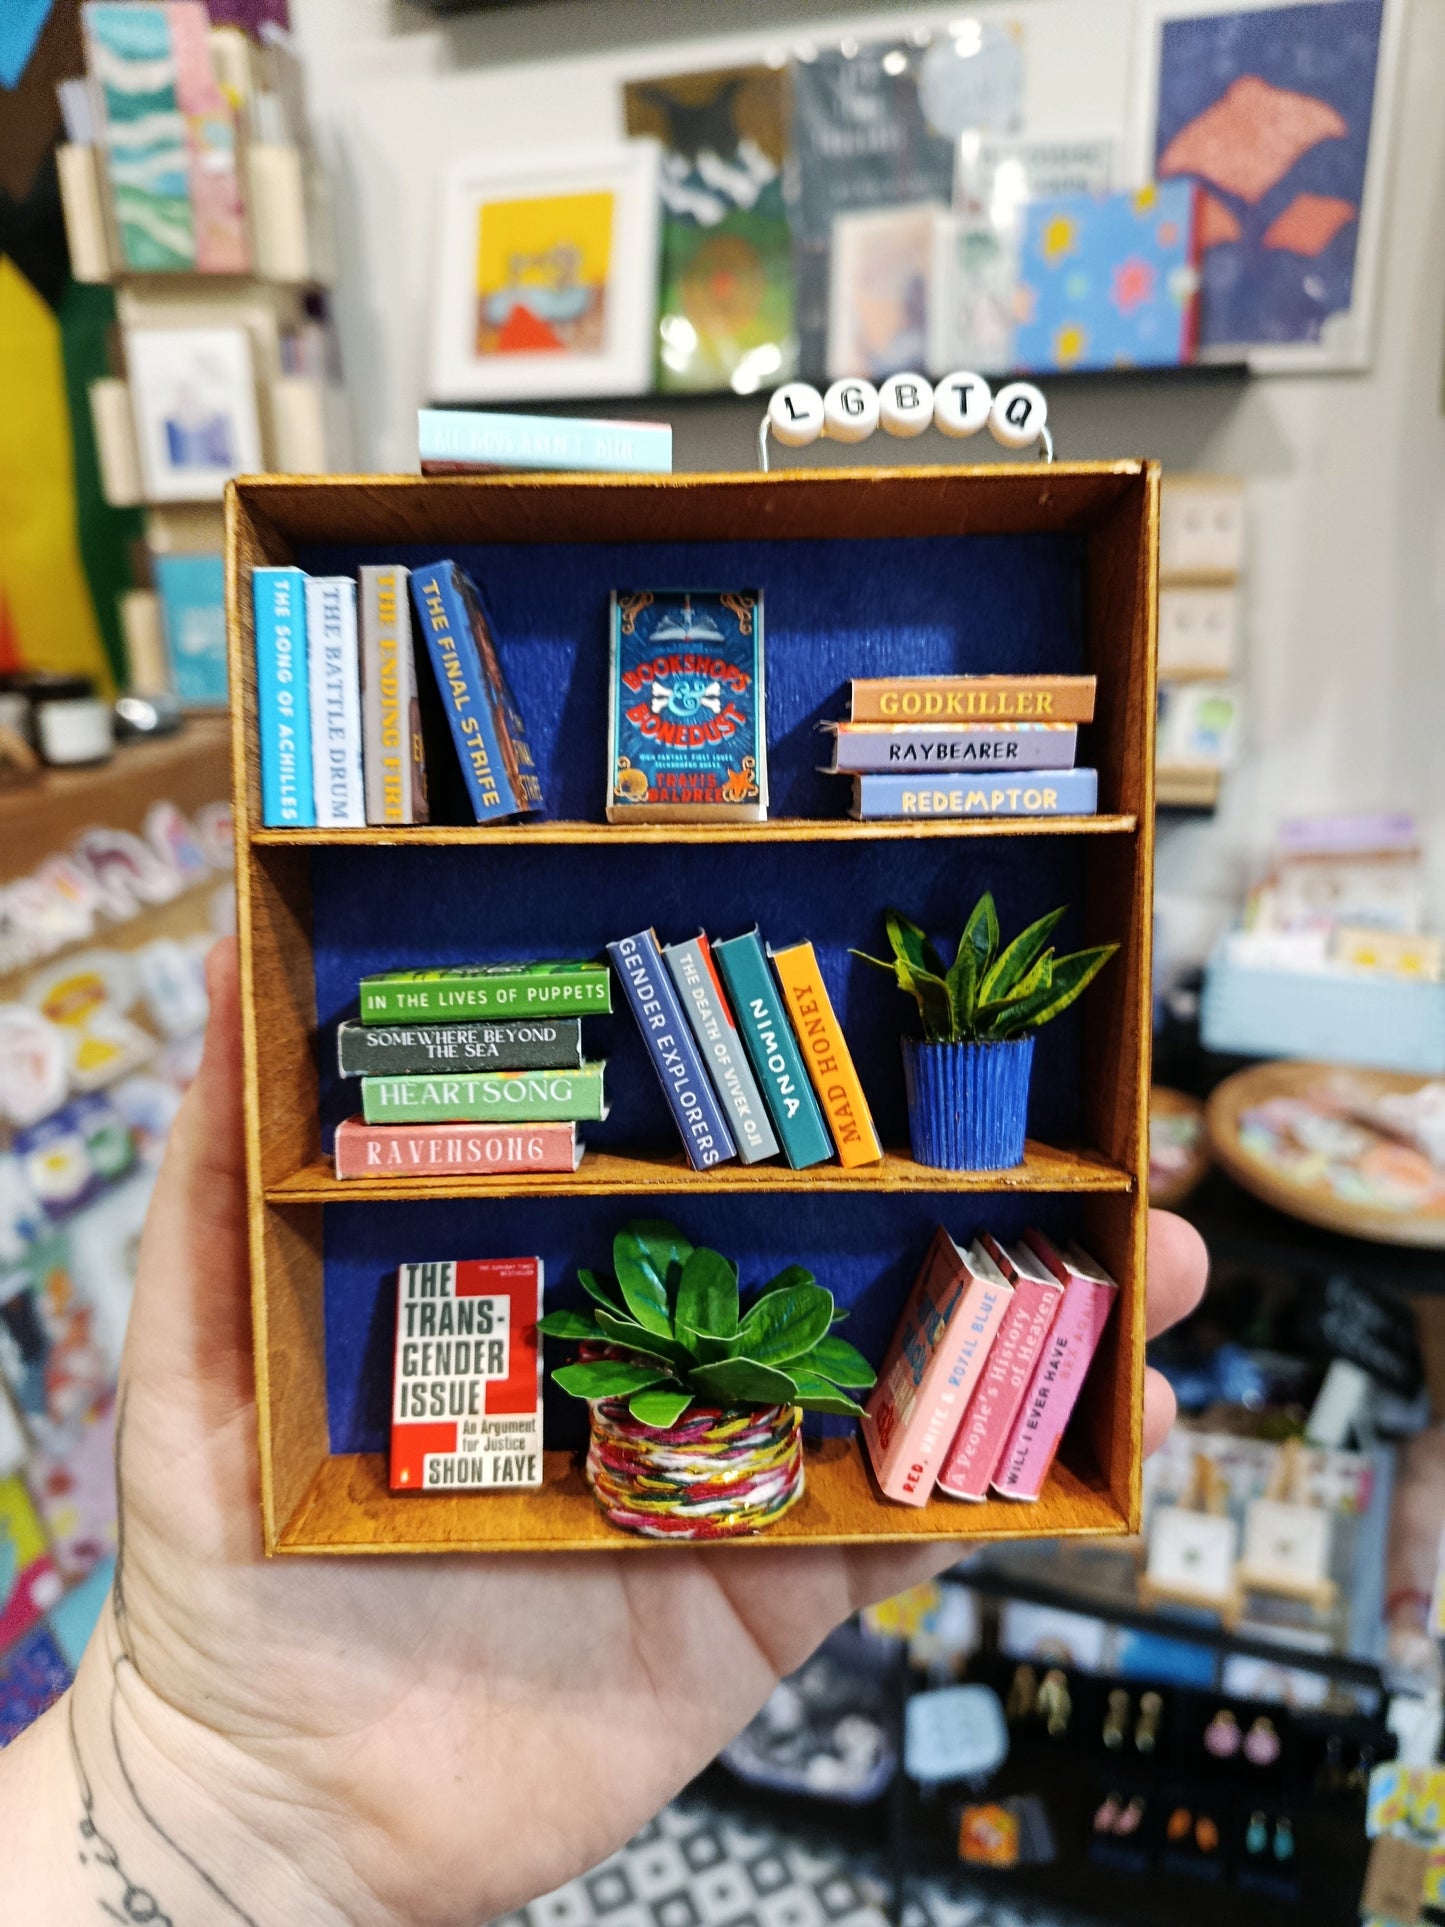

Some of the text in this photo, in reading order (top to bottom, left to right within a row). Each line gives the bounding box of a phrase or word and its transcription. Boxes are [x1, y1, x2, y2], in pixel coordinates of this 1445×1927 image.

[784, 384, 1033, 430] LGBTQ
[422, 578, 501, 808] THE FINAL STRIFE
[621, 653, 753, 694] BOOKSHOPS
[273, 579, 299, 821] THE SONG OF ACHILLES
[322, 586, 349, 820] THE BATTLE DRUM
[376, 572, 404, 824] THE ENDING FIRE
[879, 691, 1054, 716] GODKILLER
[625, 702, 747, 750] BONEDUST
[889, 741, 1019, 761] RAYBEARER
[656, 772, 717, 788] TRAVIS
[901, 787, 1058, 813] REDEMPTOR
[367, 983, 606, 1010] IN THE LIVES OF PUPPETS
[366, 1027, 557, 1048] SOMEWHERE BEYOND
[426, 1042, 500, 1059] THE SEA
[619, 938, 720, 1166] GENDER EXPLORERS
[679, 952, 763, 1148] THE DEATH OF VIVEK OJI
[749, 997, 801, 1119] NIMONA
[792, 984, 862, 1146] MAD HONEY
[379, 1079, 574, 1107] HEARTSONG
[367, 1136, 544, 1166] RAVENSONG
[406, 1263, 453, 1299] THE
[404, 1298, 506, 1338] TRANS-
[402, 1338, 505, 1378] GENDER
[948, 1337, 979, 1389] ROYAL
[971, 1290, 998, 1334] BLUE
[1010, 1291, 1057, 1388] of Heaven
[399, 1379, 481, 1418] ISSUE
[952, 1306, 1032, 1487] A People's History
[1005, 1337, 1069, 1487] WILL I EVER HAVE
[462, 1417, 537, 1437] An Argument
[462, 1436, 526, 1453] for Justice
[428, 1454, 537, 1485] SHON FAYE
